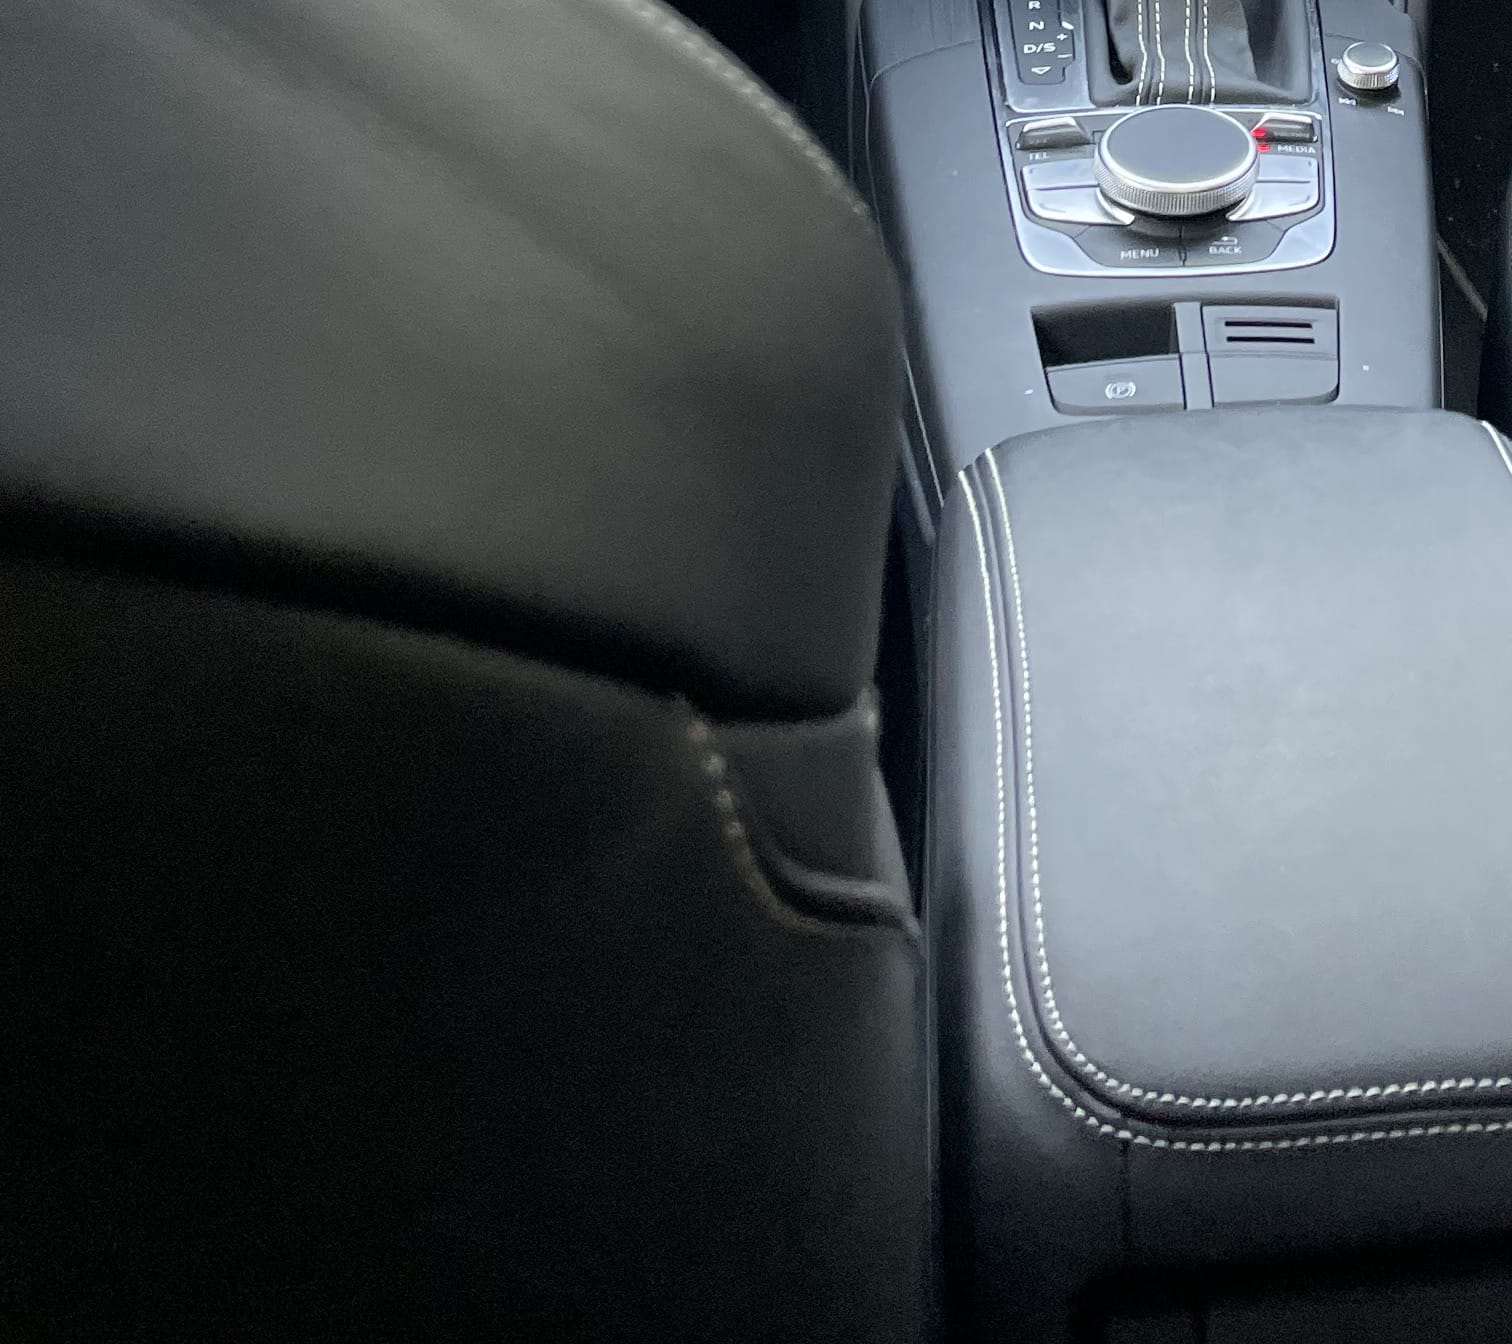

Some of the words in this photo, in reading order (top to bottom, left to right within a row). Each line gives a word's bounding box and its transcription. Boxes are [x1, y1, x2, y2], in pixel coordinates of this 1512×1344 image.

[1028, 0, 1041, 10] R
[1028, 20, 1045, 31] N
[1023, 42, 1057, 54] D/S
[1277, 143, 1317, 154] MEDIA
[1120, 248, 1160, 260] MENU
[1208, 245, 1242, 256] BACK
